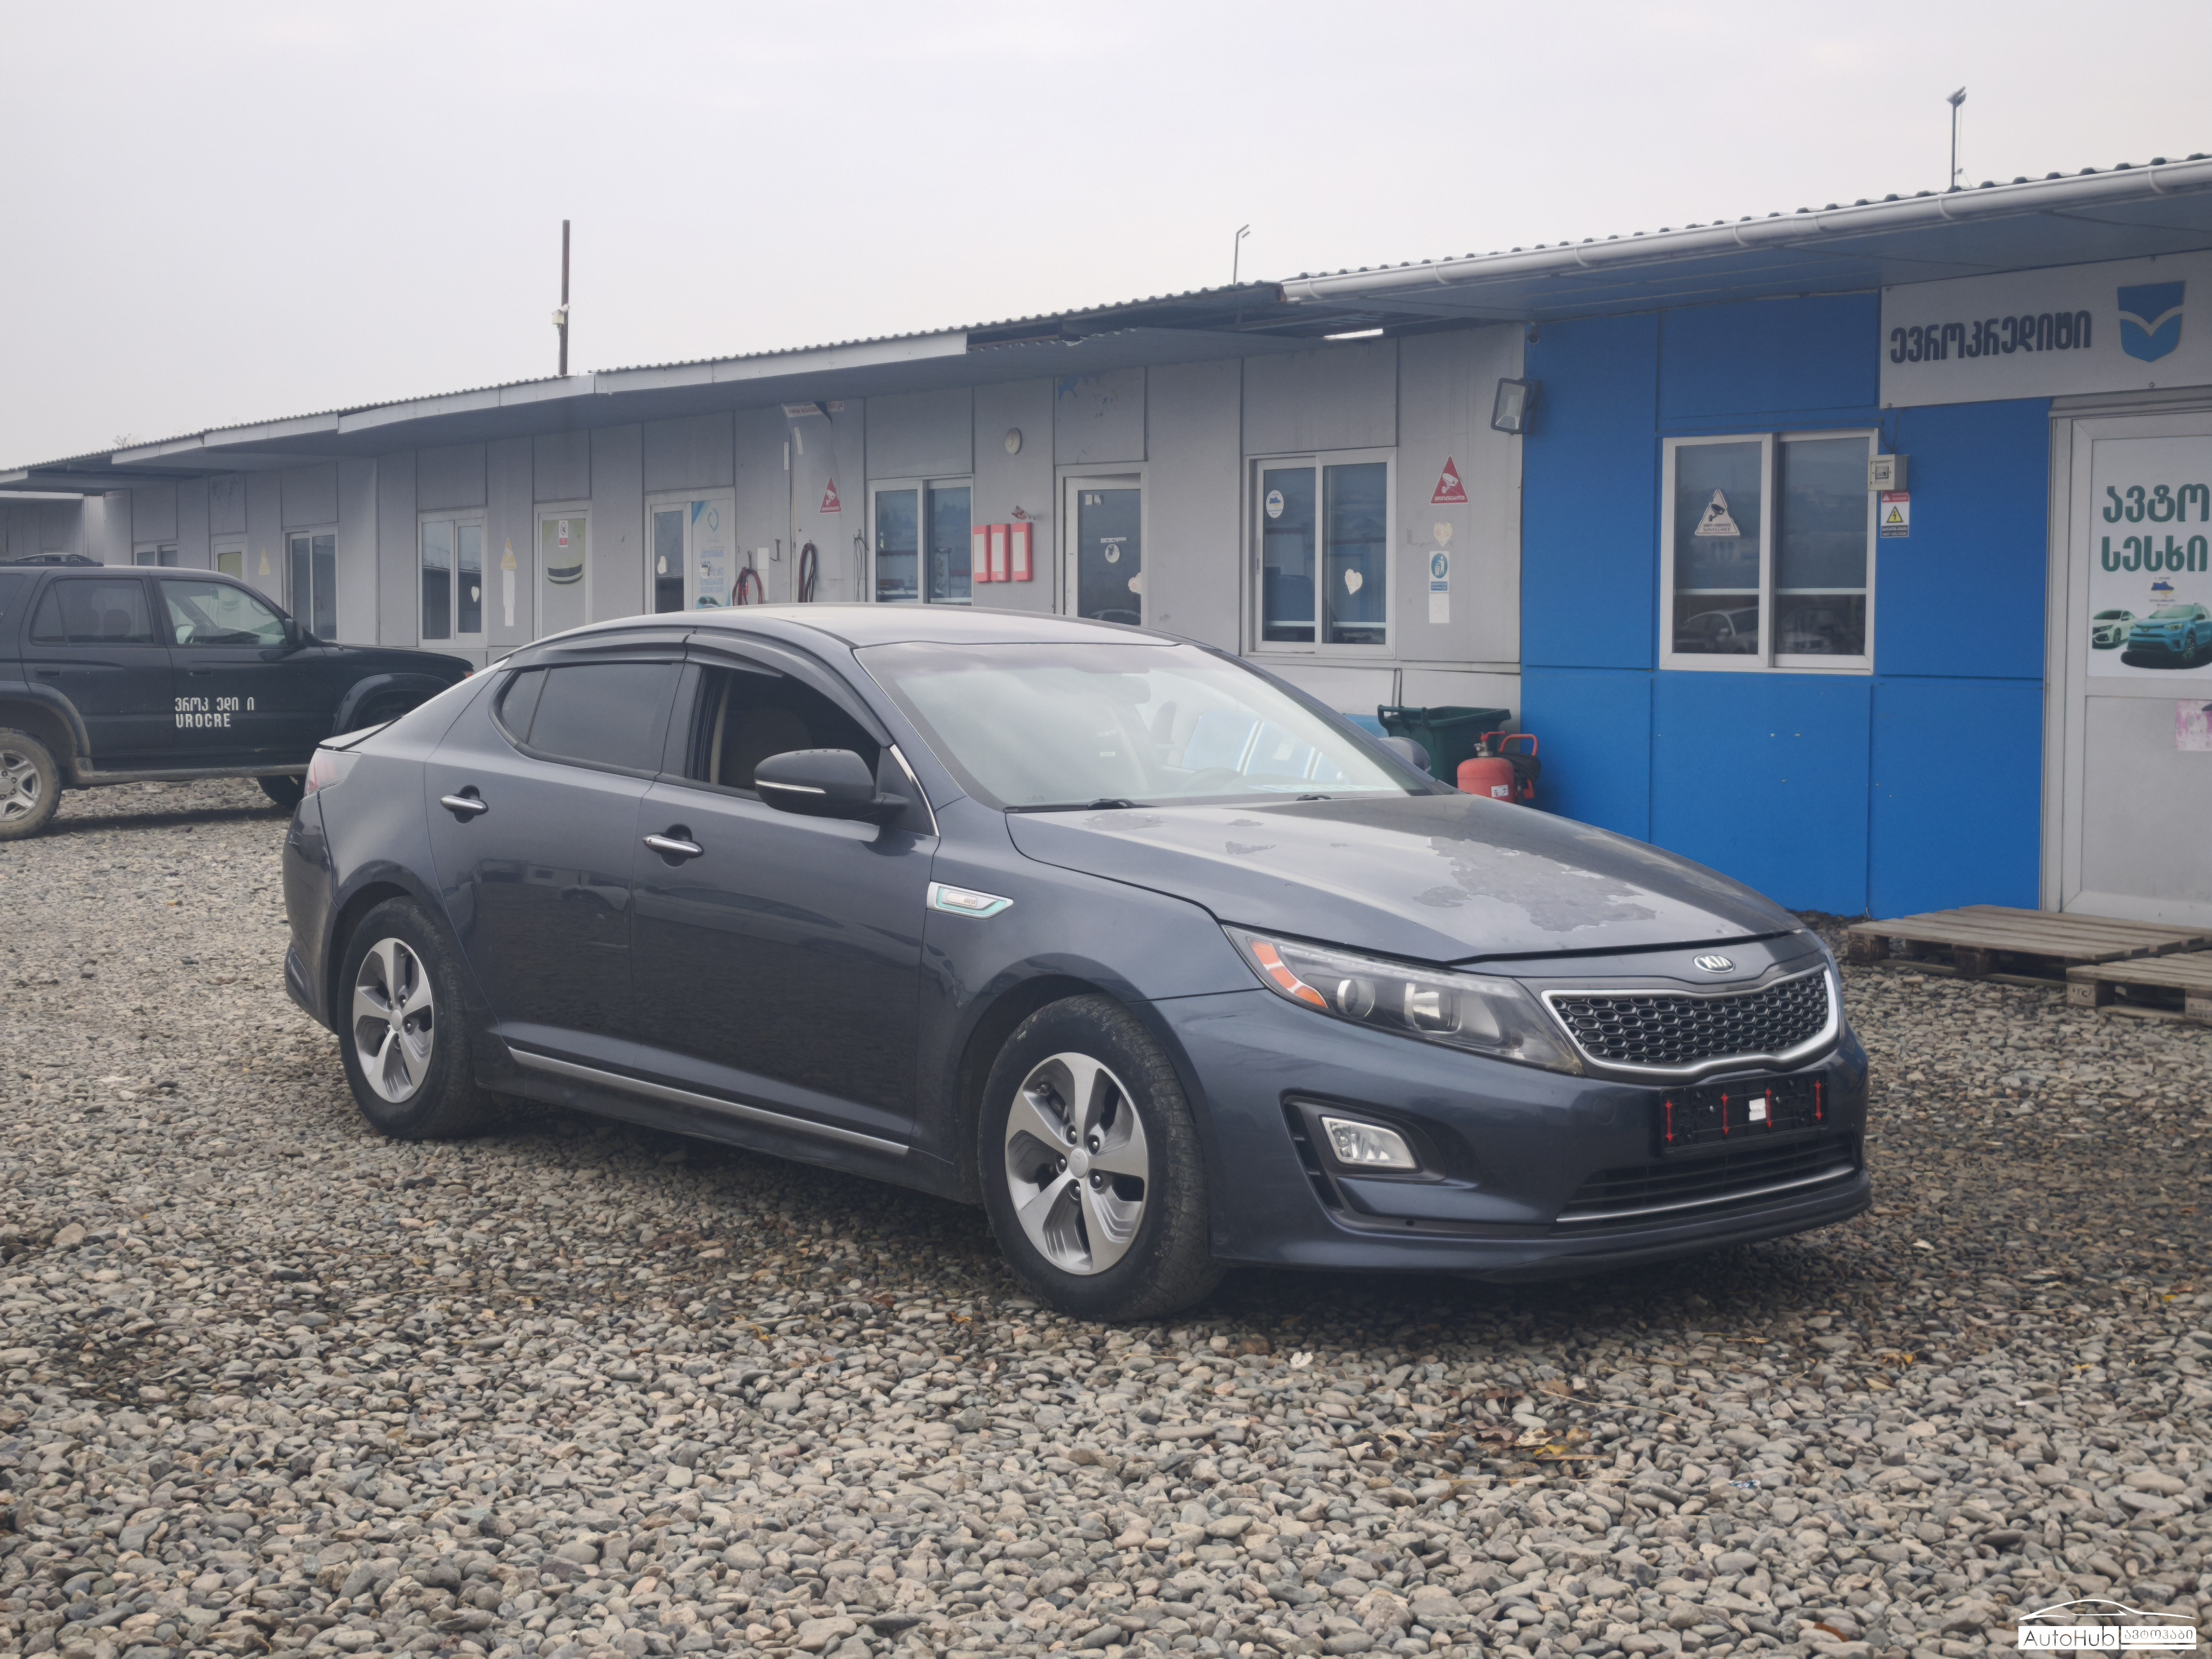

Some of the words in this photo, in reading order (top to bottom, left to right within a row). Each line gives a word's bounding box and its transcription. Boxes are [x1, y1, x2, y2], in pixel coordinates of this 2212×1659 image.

[1890, 309, 2092, 363] ევროკრედიტი
[2102, 483, 2210, 523] ავტო
[2101, 535, 2208, 572] სესხი
[176, 713, 231, 728] UROCRE
[1698, 955, 1732, 968] KIA
